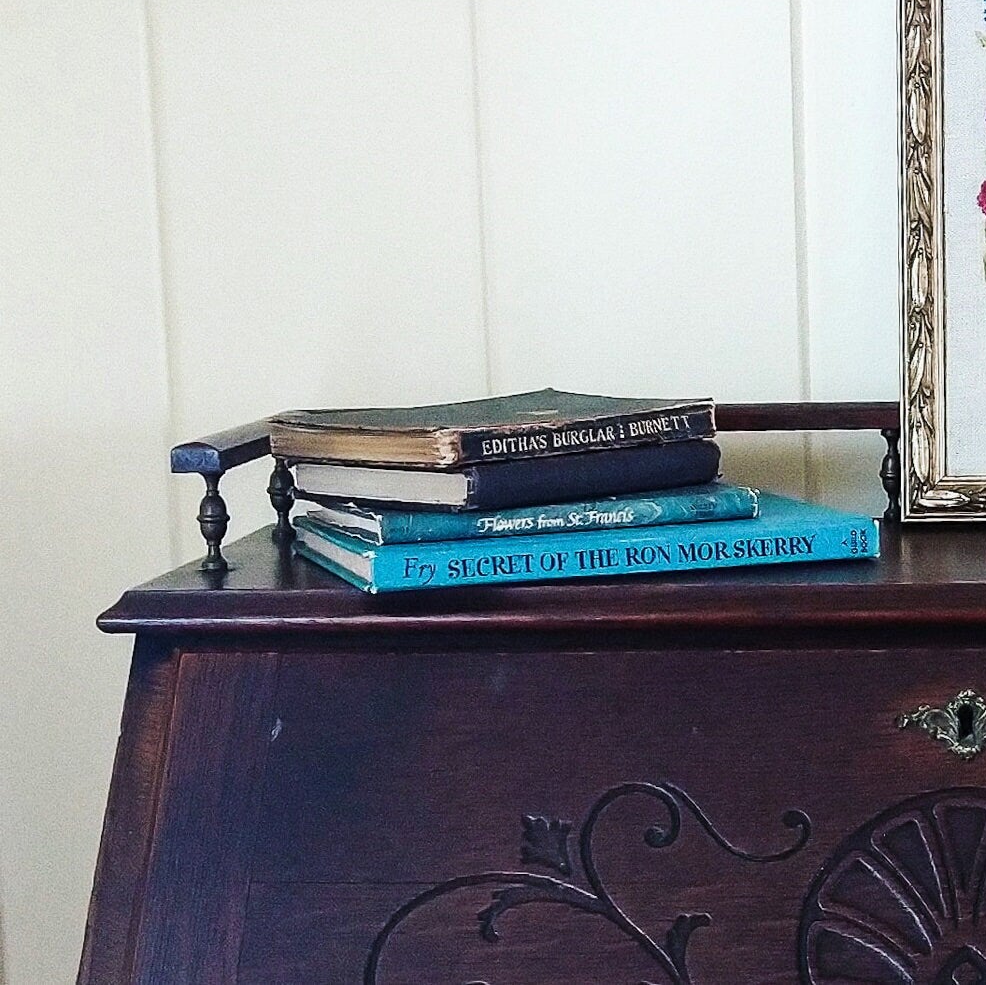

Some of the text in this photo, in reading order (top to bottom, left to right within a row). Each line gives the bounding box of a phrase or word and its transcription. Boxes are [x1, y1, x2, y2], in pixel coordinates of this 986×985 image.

[482, 415, 690, 456] EDITHA'S BURGLAR BURNETT
[477, 517, 534, 533] Flowers
[537, 514, 565, 529] from
[584, 507, 634, 525] Francis
[403, 534, 816, 585] Fry SECRET OF THE RON MOR SKERRY
